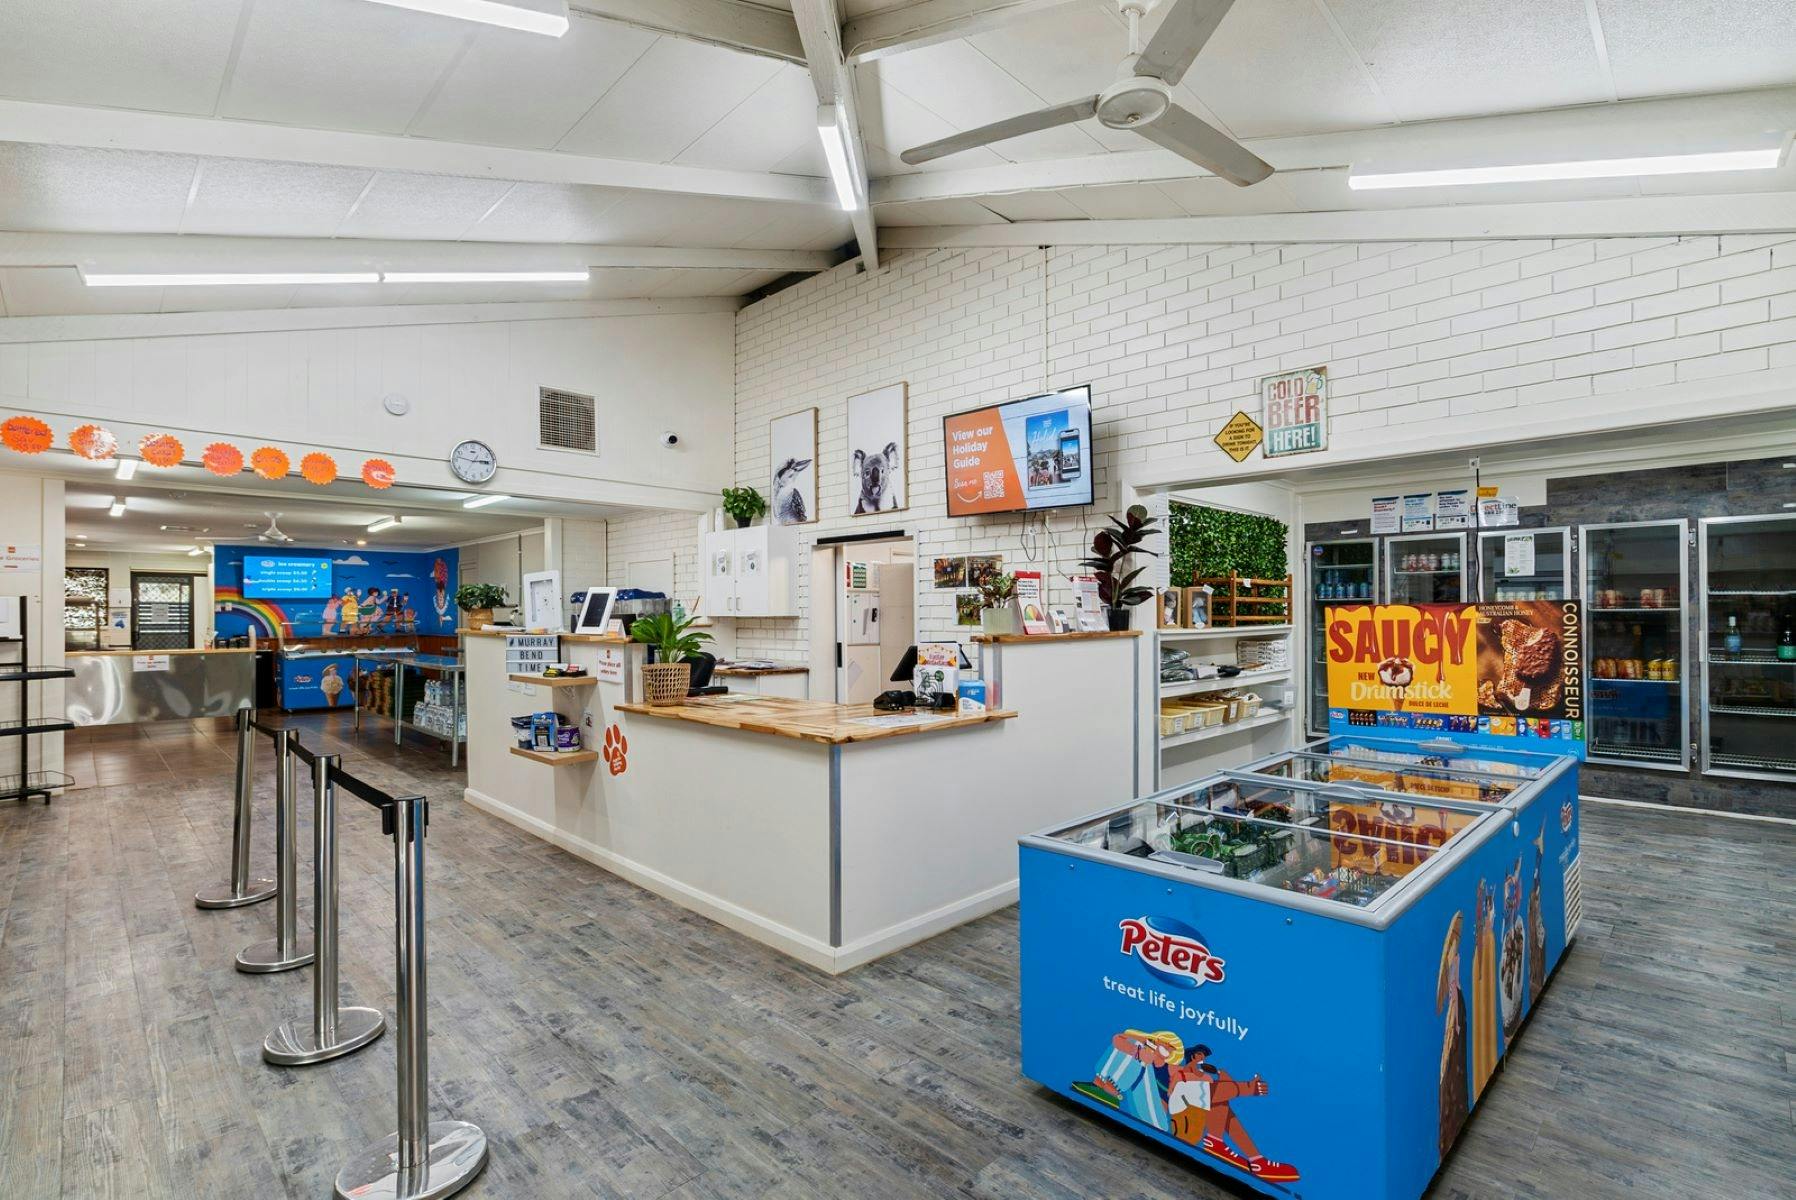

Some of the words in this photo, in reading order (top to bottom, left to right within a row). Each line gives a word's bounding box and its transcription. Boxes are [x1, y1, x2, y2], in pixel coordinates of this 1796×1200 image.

[1268, 377, 1303, 401] COLD
[1268, 395, 1320, 429] BEER
[952, 429, 975, 442] View
[977, 426, 993, 437] our
[1273, 426, 1315, 451] HERE!
[953, 441, 989, 455] Holiday
[953, 456, 981, 469] Guide
[517, 637, 555, 648] MURRAY
[1329, 618, 1472, 665] SAUCY
[520, 650, 543, 660] BEND
[1562, 602, 1580, 719] CONNOISSEUR
[518, 663, 542, 673] TIME
[1358, 671, 1376, 681] NEW
[1351, 681, 1453, 701] Drumstick
[1408, 700, 1424, 708] DULCE
[1433, 701, 1449, 709] LECHE
[1120, 919, 1225, 982] Peters
[1103, 975, 1145, 1001] treat
[1149, 989, 1176, 1012] life
[1179, 1000, 1249, 1041] joyfully
